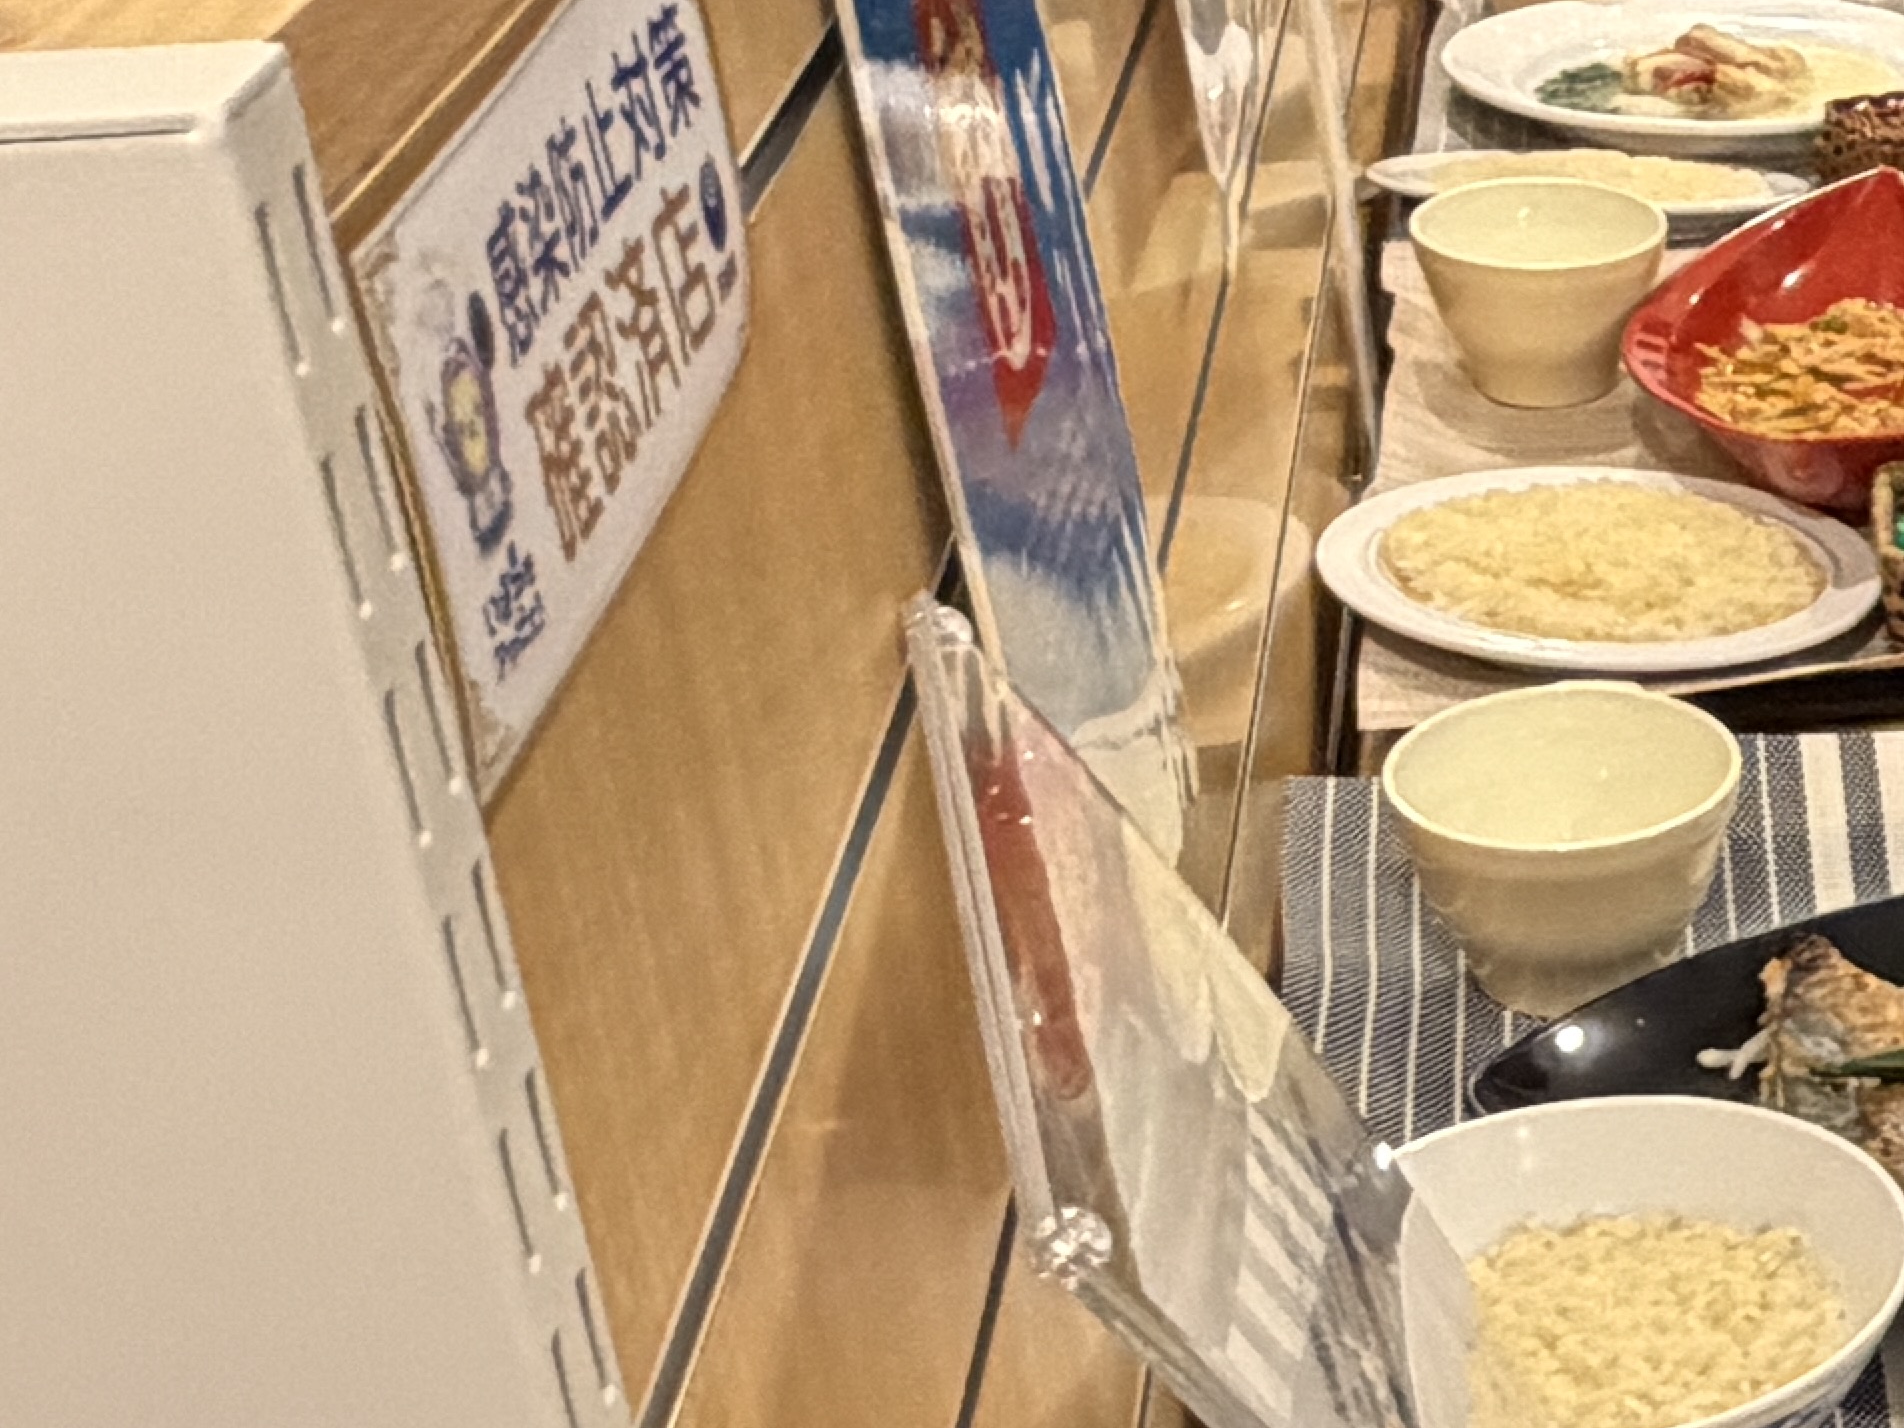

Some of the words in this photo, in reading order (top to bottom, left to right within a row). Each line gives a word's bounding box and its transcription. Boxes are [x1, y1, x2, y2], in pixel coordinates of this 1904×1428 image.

[485, 1, 702, 370] 感染防止対策
